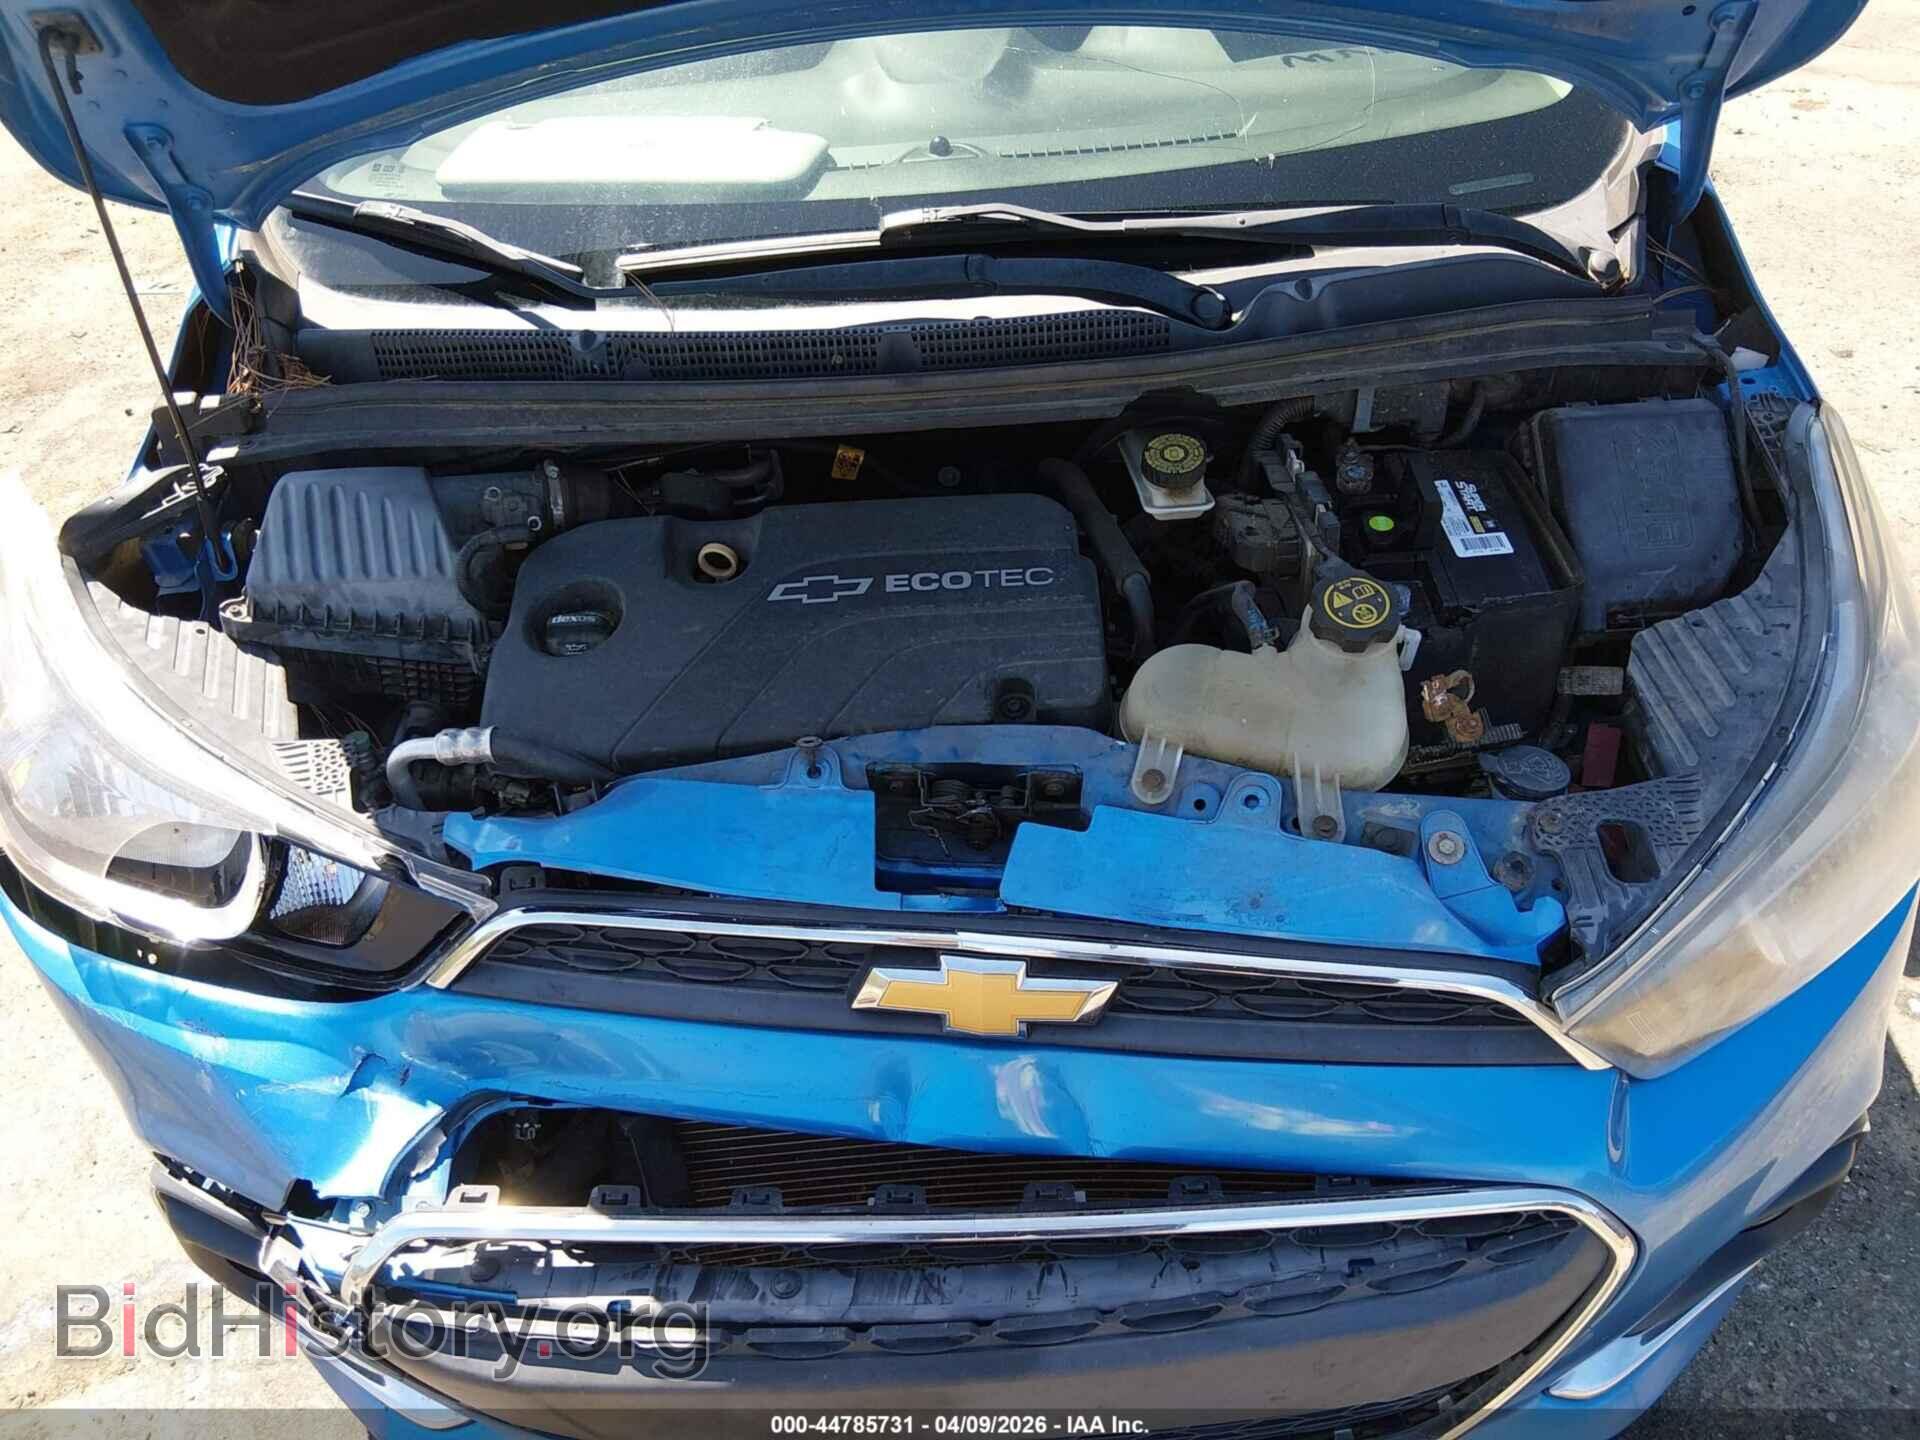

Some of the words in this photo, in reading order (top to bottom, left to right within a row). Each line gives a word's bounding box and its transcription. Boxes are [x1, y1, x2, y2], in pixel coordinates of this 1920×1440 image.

[1454, 481, 1475, 511] START
[885, 567, 1054, 592] ECOTEC
[551, 614, 597, 624] dexos
